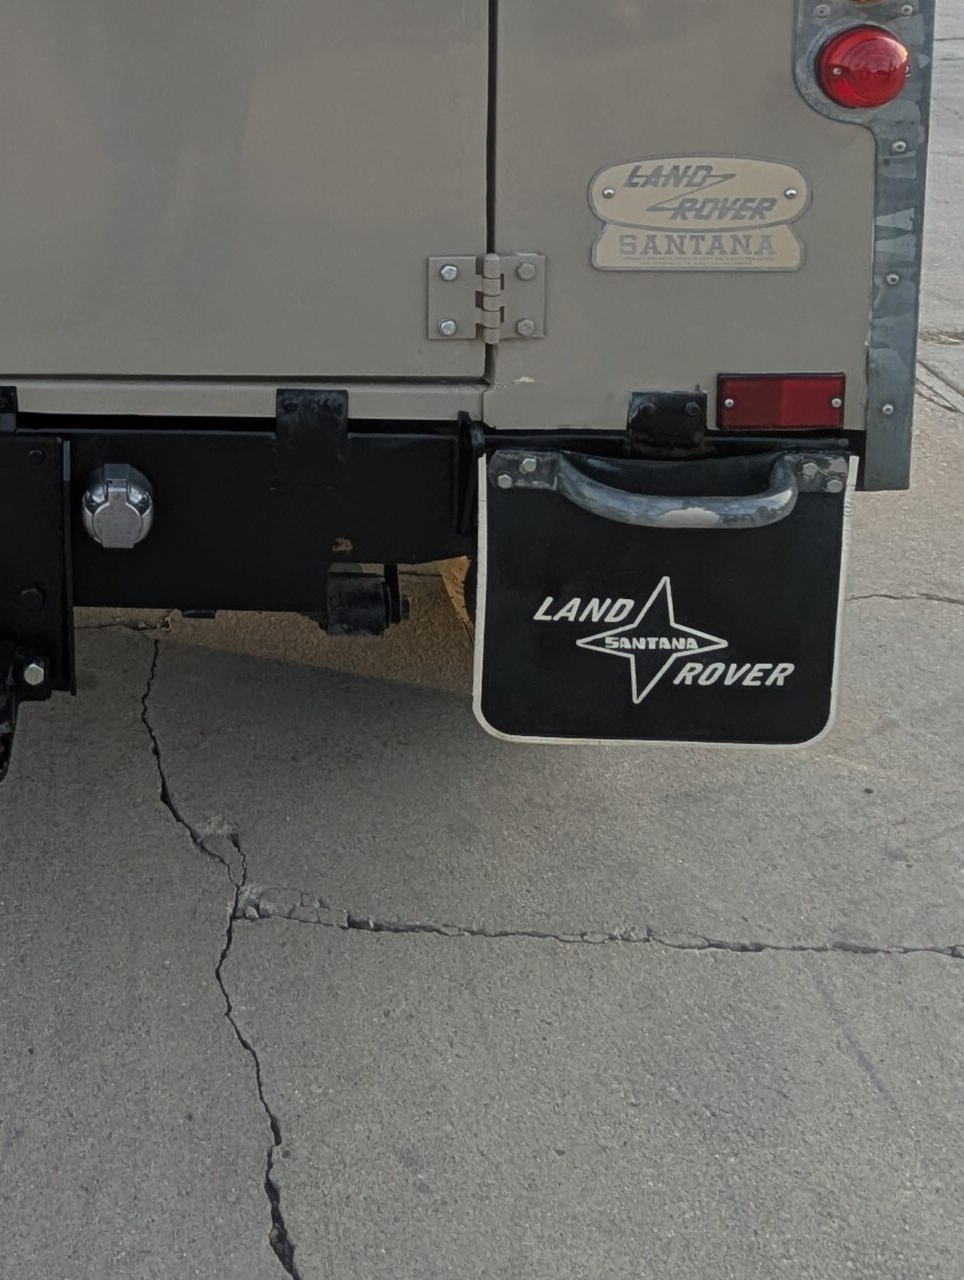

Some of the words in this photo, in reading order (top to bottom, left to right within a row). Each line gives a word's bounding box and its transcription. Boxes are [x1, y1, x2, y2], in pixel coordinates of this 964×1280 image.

[623, 164, 714, 188] LAND
[669, 196, 778, 221] ROVER
[619, 234, 777, 256] SANTANA
[533, 596, 636, 623] LAND
[605, 636, 699, 650] SANTANA
[673, 662, 796, 687] ROVER
